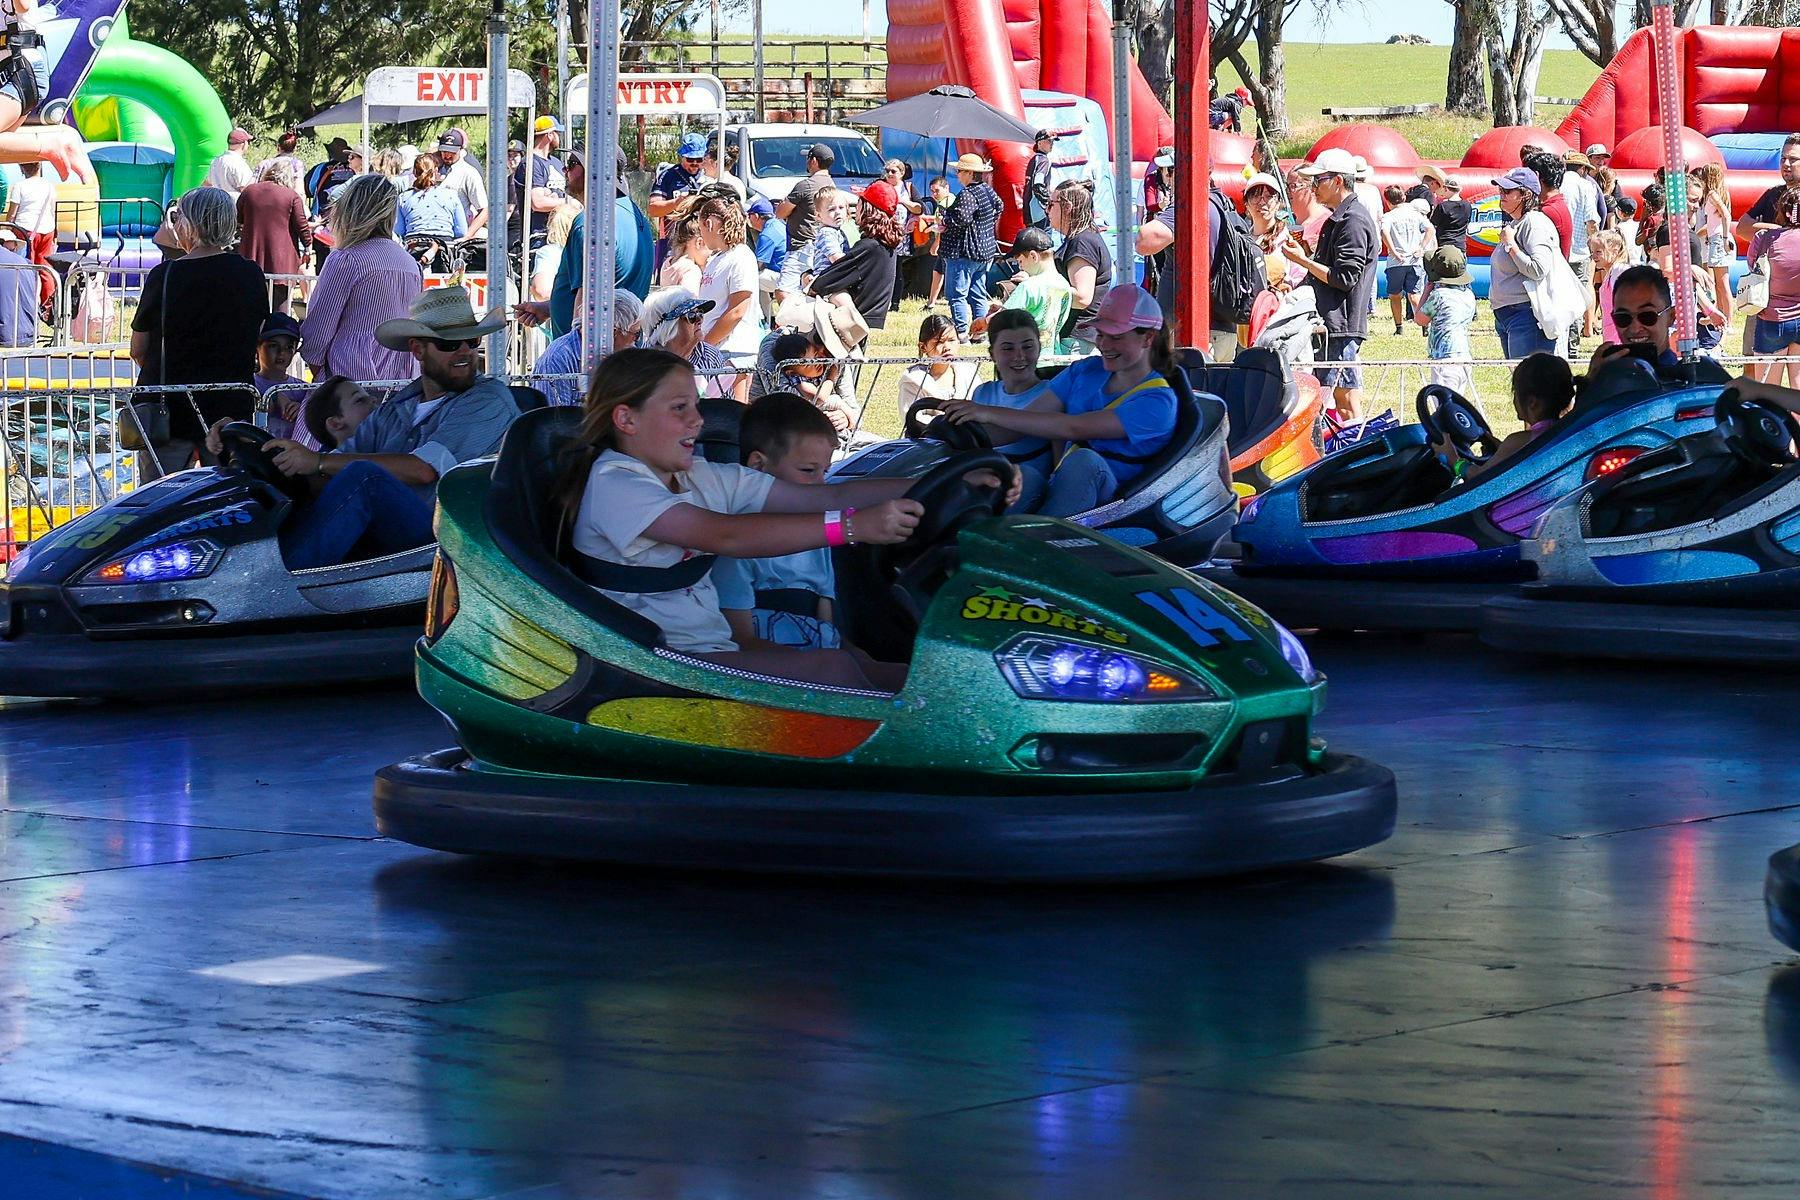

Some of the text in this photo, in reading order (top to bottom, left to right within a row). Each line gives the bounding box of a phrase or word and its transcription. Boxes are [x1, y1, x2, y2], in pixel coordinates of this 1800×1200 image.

[416, 73, 484, 102] EXIT
[617, 81, 693, 104] NTRY
[961, 595, 1129, 644] SHORTS
[1135, 587, 1253, 647] 14
